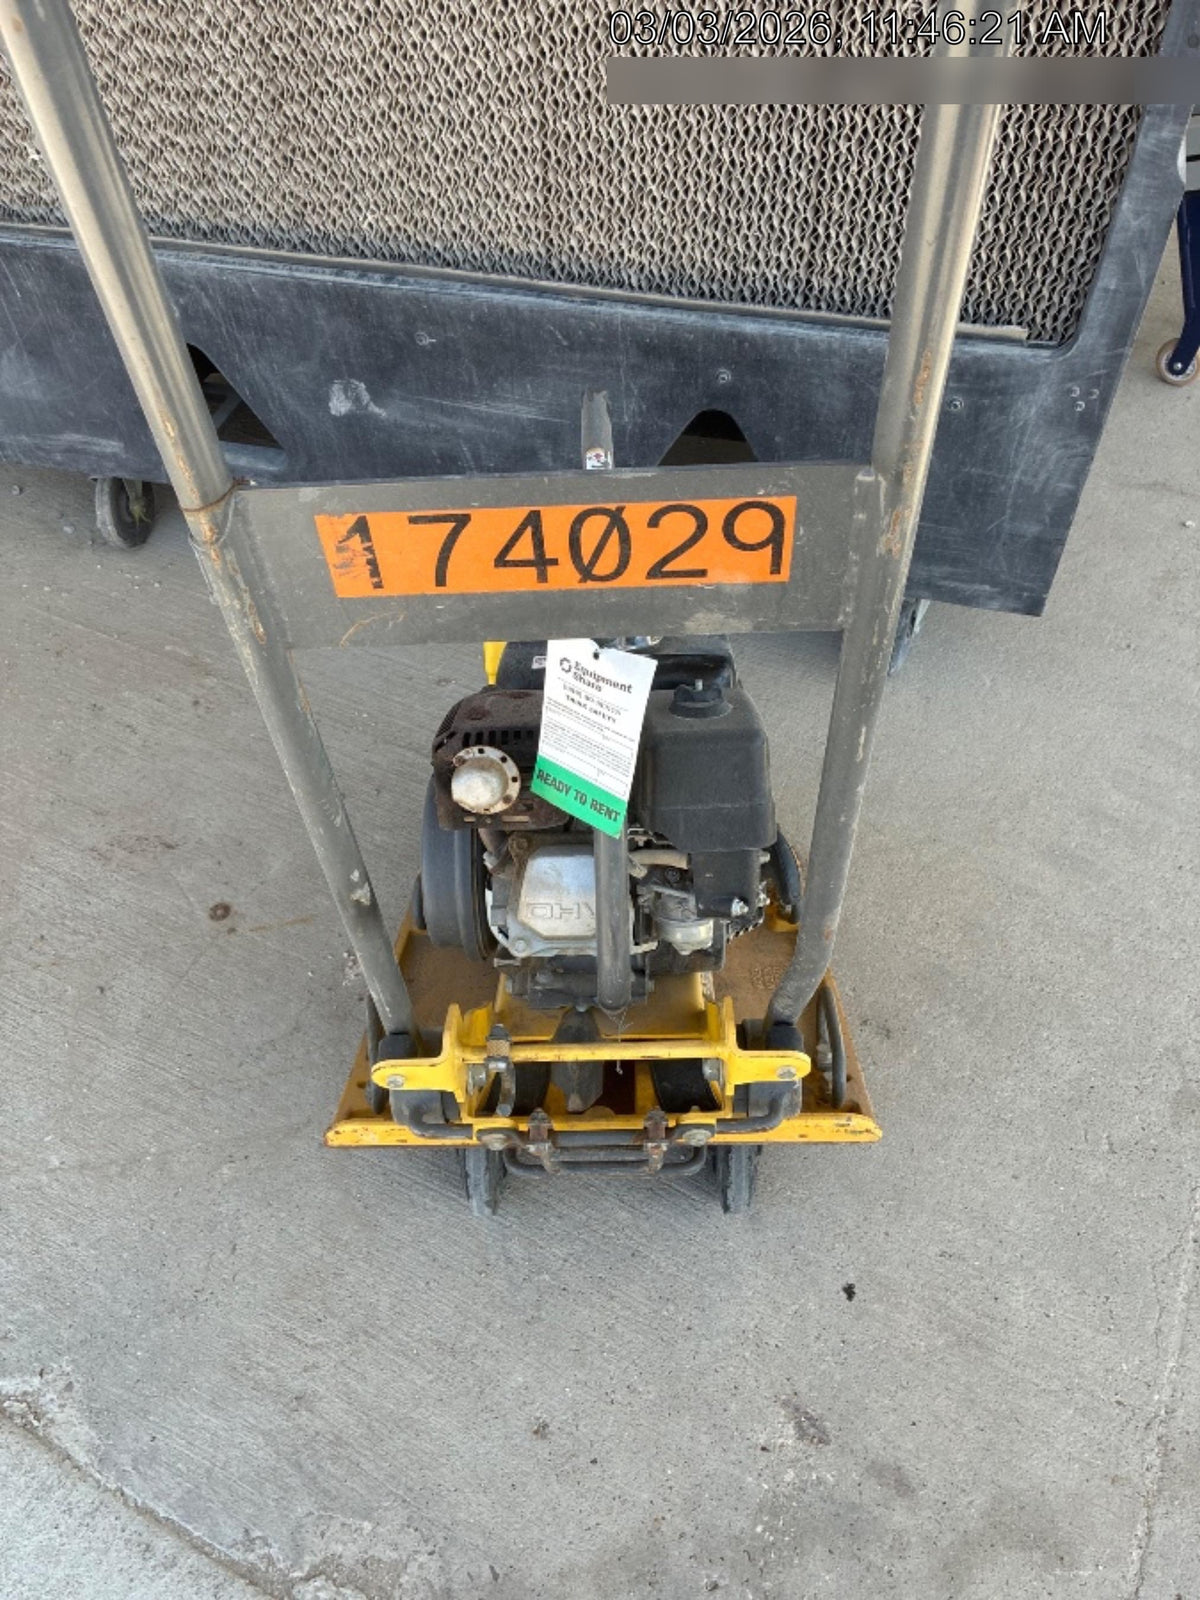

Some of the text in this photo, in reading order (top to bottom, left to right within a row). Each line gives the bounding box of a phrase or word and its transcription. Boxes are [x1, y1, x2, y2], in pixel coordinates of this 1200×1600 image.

[333, 500, 787, 590] 174029
[572, 671, 603, 693] Share
[573, 660, 633, 694] Equipment
[536, 769, 621, 822] READY TO RENT
